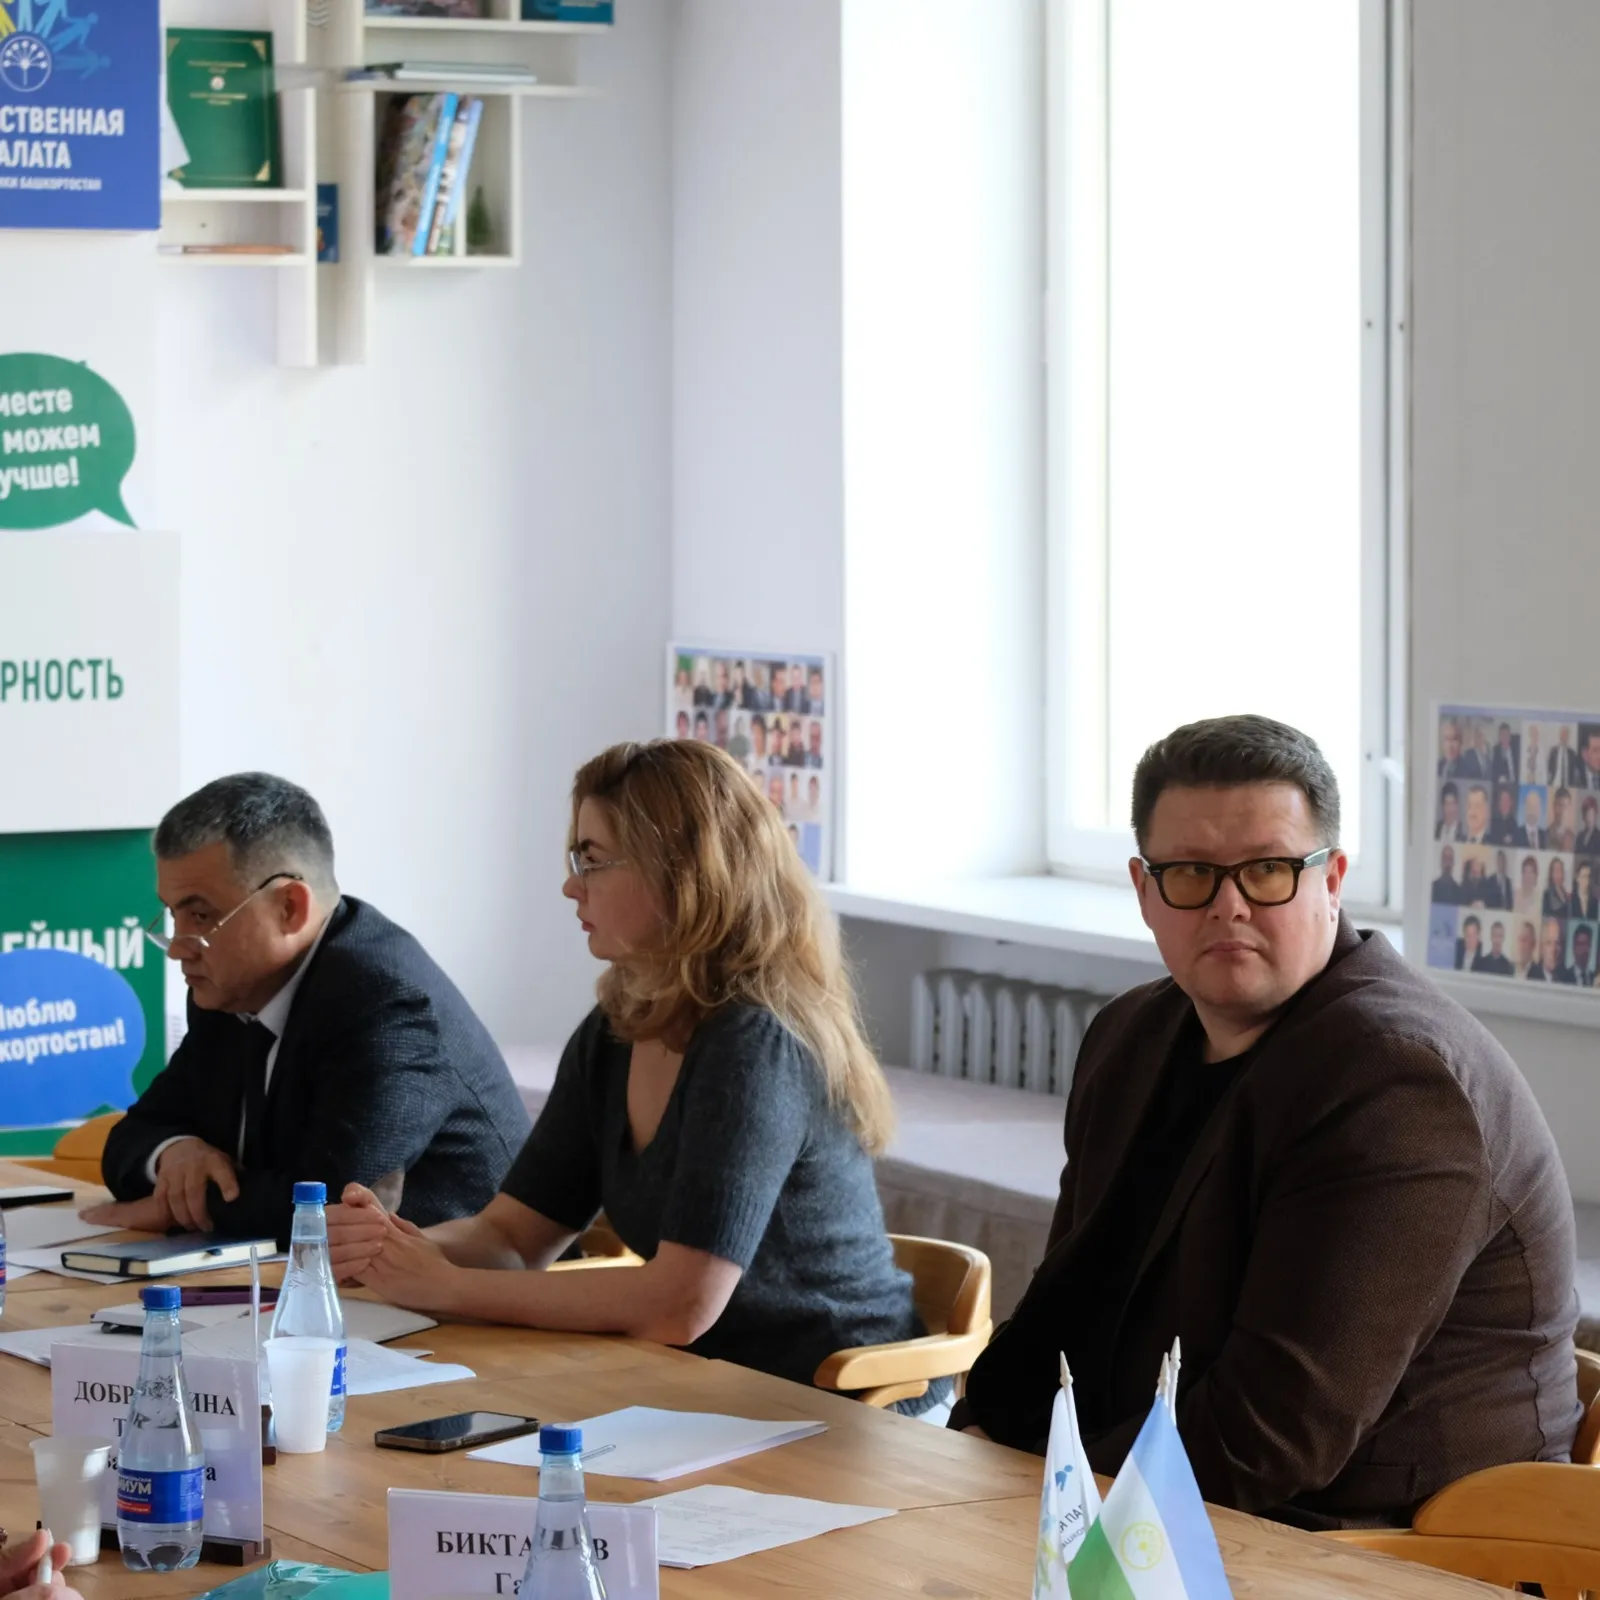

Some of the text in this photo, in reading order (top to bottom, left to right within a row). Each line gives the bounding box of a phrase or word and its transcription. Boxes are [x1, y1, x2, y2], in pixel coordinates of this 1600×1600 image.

[0, 105, 124, 136] СТВЕННАЯ
[3, 423, 100, 454] можем
[0, 658, 124, 702] РНОСТЬ
[436, 1531, 609, 1561] БИКТАВ
